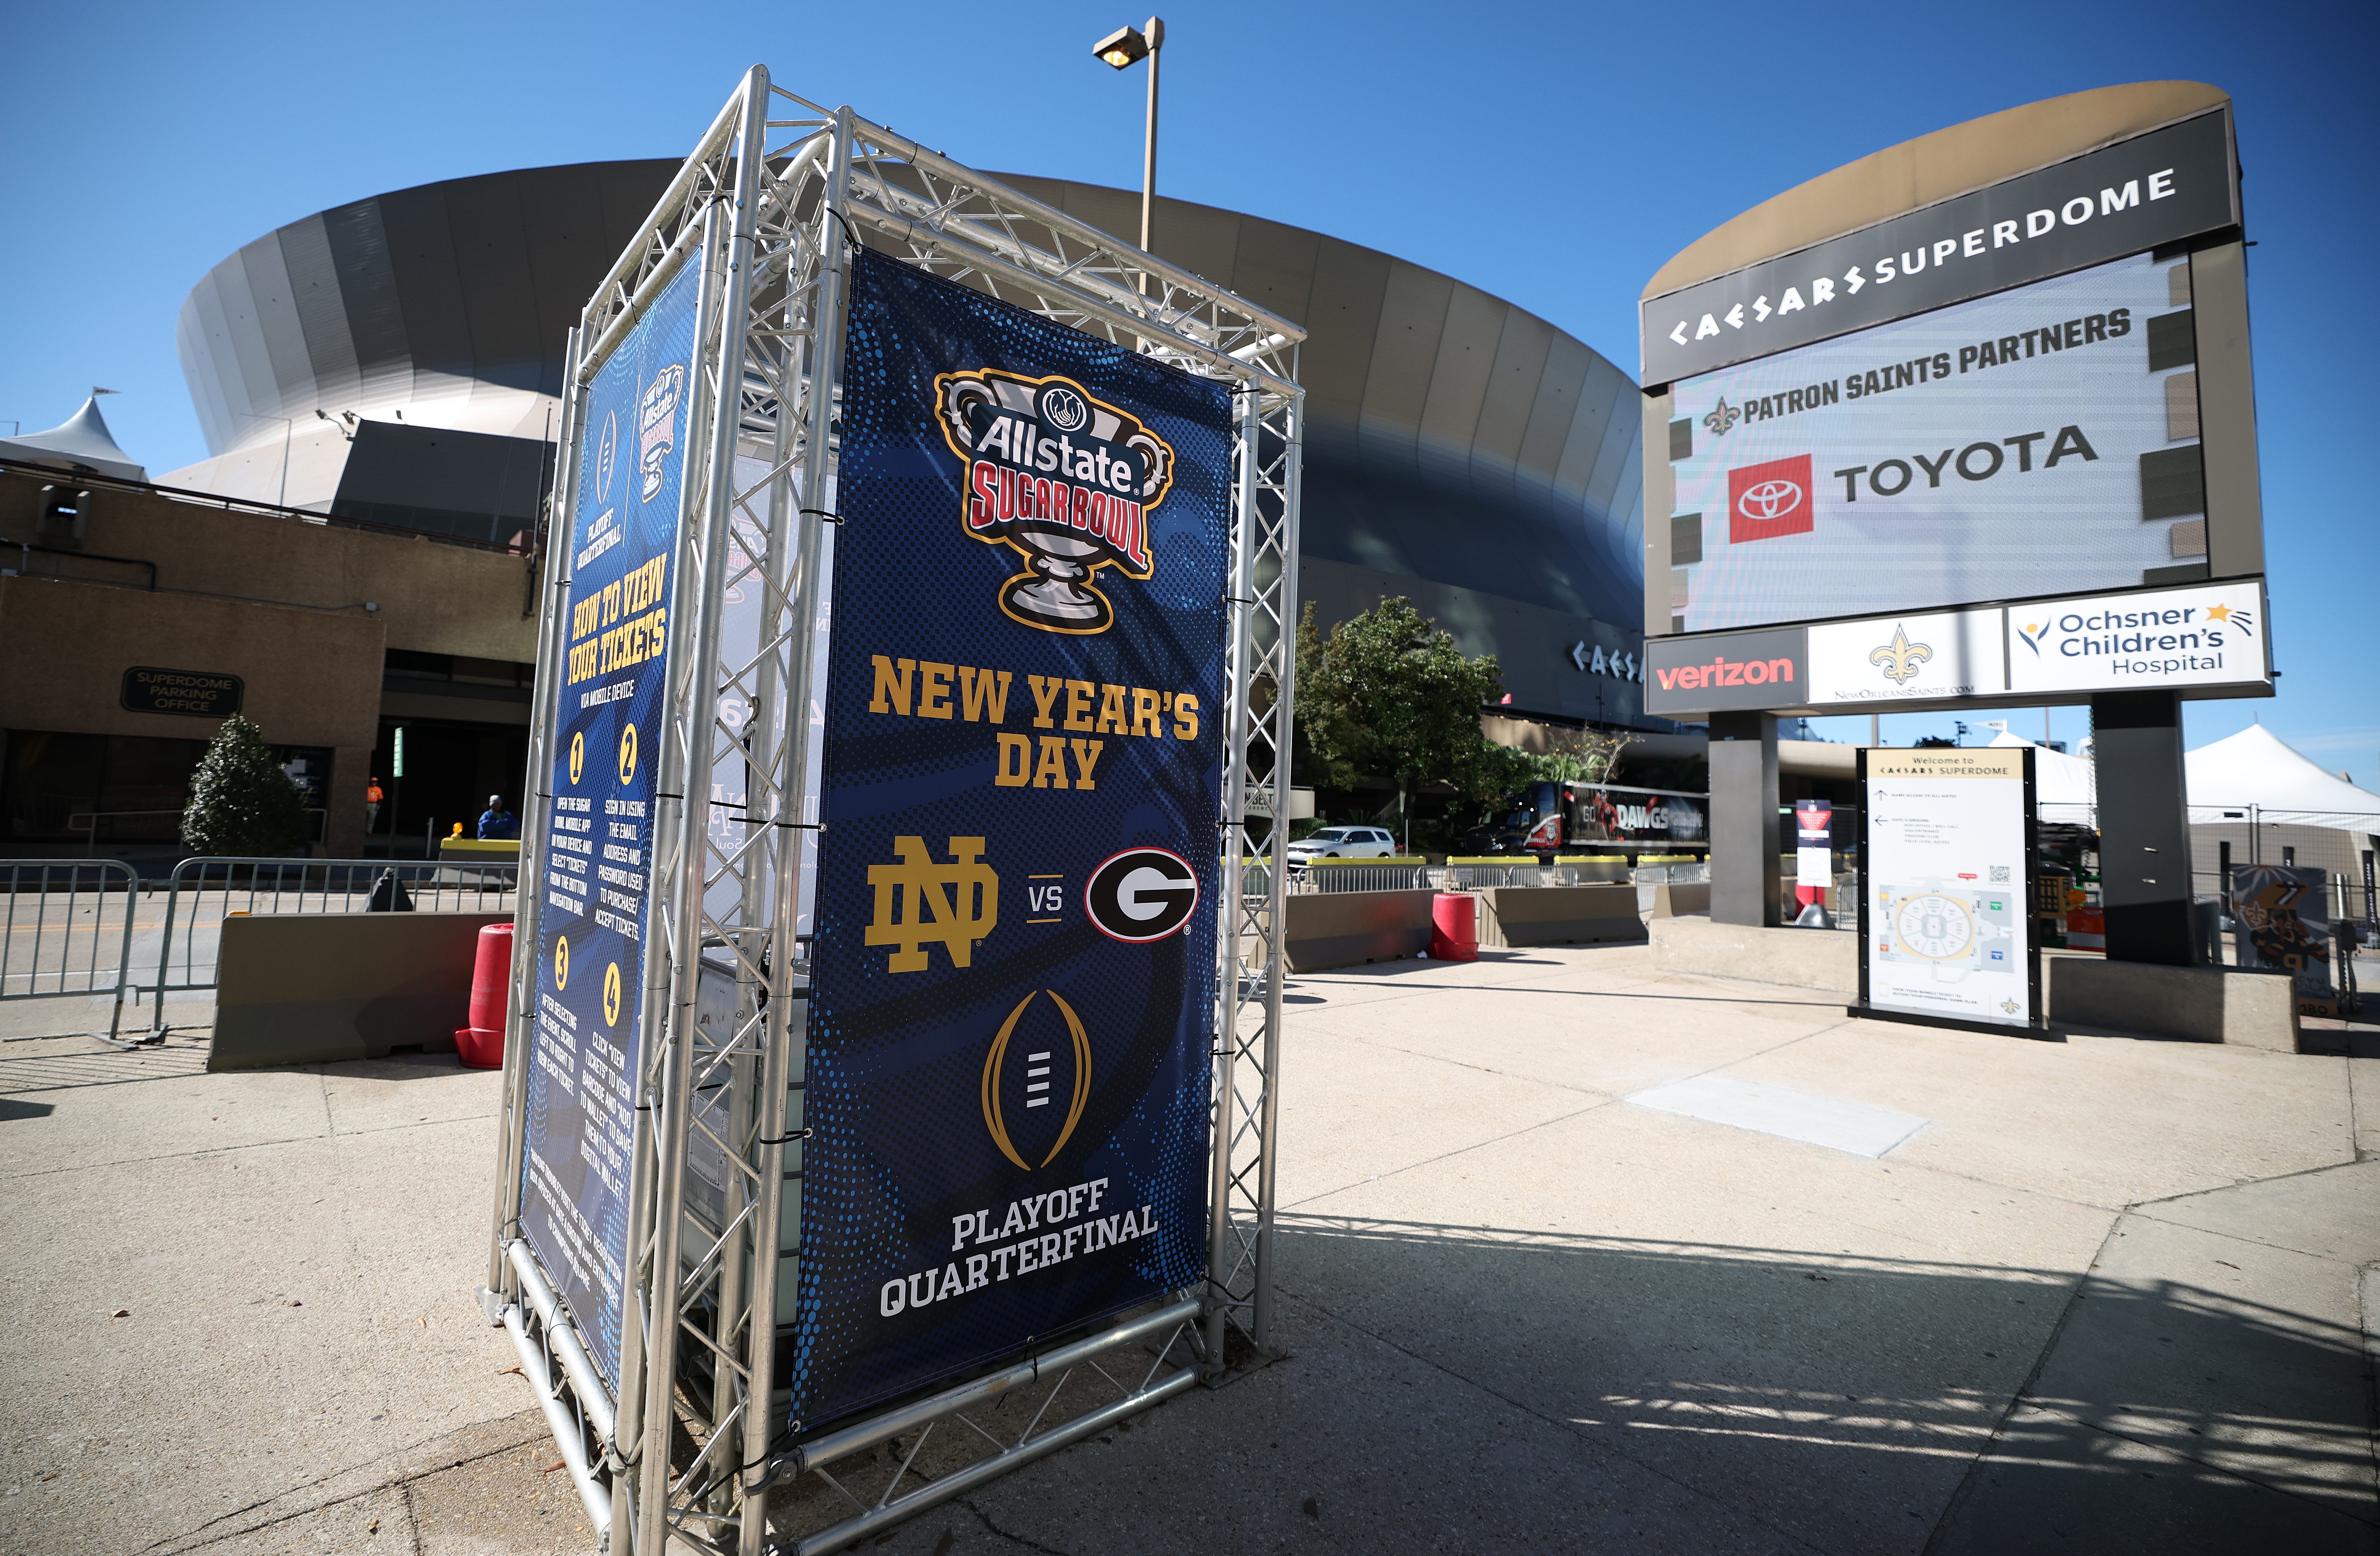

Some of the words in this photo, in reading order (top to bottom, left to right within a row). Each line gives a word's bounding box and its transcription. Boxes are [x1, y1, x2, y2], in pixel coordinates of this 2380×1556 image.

[1669, 265, 1866, 345] CAESARS
[1874, 168, 2176, 285] SUPERDOME
[1744, 377, 1839, 424] PATRON
[1846, 352, 1951, 401] SAINTS
[1960, 308, 2130, 375] PARTNERS
[1834, 425, 2098, 502] TOYOTA
[588, 508, 614, 543] PLAYOFF
[970, 460, 1070, 529] SUGAR
[1071, 485, 1148, 570] BOWL
[577, 524, 621, 570] QUARTERFINAL
[572, 591, 600, 642] HOW
[602, 580, 620, 627] TO
[623, 552, 667, 617] VIEW
[2060, 605, 2195, 634] Ochsner
[568, 638, 598, 686] YOUR
[600, 608, 666, 674] TICKETS
[2113, 652, 2222, 676] Hospital
[137, 673, 232, 689] SUPERDOME
[150, 686, 217, 700] PARKING
[1656, 658, 1793, 692] verizon
[155, 698, 210, 711] OFFICE
[581, 690, 590, 708] VIA
[590, 686, 611, 705] MOBILE
[612, 679, 635, 701] DEVICE
[869, 655, 1012, 724] NEW
[1028, 675, 1199, 740] YEAR'S
[573, 739, 580, 778] 1
[623, 732, 632, 777] 2
[995, 732, 1104, 790] DAY
[557, 797, 567, 810] OPEN
[576, 798, 590, 812] SUGAR
[605, 800, 618, 815] SIGN
[619, 801, 625, 815] IN
[627, 801, 645, 817] USING
[1616, 804, 1669, 829] DAWGS
[555, 815, 565, 829] BOWL
[566, 817, 581, 832] MOBILE
[581, 819, 590, 833] APP
[609, 822, 619, 837] THE
[620, 824, 637, 840] EMAIL
[552, 853, 567, 868] SELECT
[556, 835, 567, 849] YOUR
[567, 836, 582, 853] DEVICE
[582, 839, 592, 855] AND
[603, 843, 628, 862] ADDRESS
[628, 848, 640, 865] AND
[550, 871, 560, 887] FROM
[569, 877, 587, 896] BOTTOM
[598, 865, 627, 887] PASSWORD
[628, 872, 643, 891] USED
[550, 890, 573, 912] NAVIGATION
[574, 900, 583, 916] BAR.
[600, 887, 607, 902] TO
[607, 890, 638, 915] PURCHASE/
[1029, 886, 1062, 912] VS
[595, 908, 615, 928] ACCEPT
[615, 916, 639, 941] TICKETS.
[558, 943, 566, 983] 3
[542, 993, 554, 1013] AFTER
[554, 1002, 577, 1030] SELECTING
[607, 971, 616, 1020] 4
[540, 1031, 549, 1049] LEFT
[549, 1038, 555, 1055] TO
[555, 1044, 568, 1067] RIGHT
[568, 1055, 574, 1073] TO
[548, 1017, 560, 1041] EVENT,
[561, 1028, 576, 1053] SCROLL
[593, 1032, 608, 1057] CLICK
[537, 1048, 548, 1069] VIEW
[547, 1058, 558, 1080] EACH
[559, 1068, 574, 1097] TICKET.
[609, 1068, 615, 1088] TO
[616, 1075, 631, 1102] VIEW
[582, 1069, 605, 1104] BARCODE
[605, 1091, 616, 1115] AND
[581, 1090, 586, 1109] TO
[609, 1119, 616, 1140] TO
[616, 1128, 631, 1157] SAVE
[585, 1119, 599, 1147] THEM
[599, 1134, 606, 1155] TO
[607, 1143, 622, 1173] YOUR
[581, 1139, 601, 1175] DIGITAL
[602, 1162, 623, 1202] WALLET.
[545, 1163, 561, 1196] TROUBLE?
[561, 1188, 570, 1212] VISIT
[579, 1213, 593, 1244] TICKET
[593, 1234, 622, 1286] RESOLUTION
[952, 1177, 1108, 1252] PLAYOFF
[530, 1168, 538, 1186] BOX
[538, 1176, 552, 1205] OFFICES
[551, 1198, 556, 1214] AT
[555, 1204, 564, 1227] GATE
[564, 1218, 567, 1230] A
[567, 1223, 581, 1255] GROUND
[581, 1247, 593, 1268] AND
[593, 1258, 618, 1309] ENTRANCES
[548, 1214, 552, 1231] TO
[552, 1221, 573, 1265] CHAMPIONS
[573, 1258, 590, 1292] SQUARE.
[880, 1204, 1158, 1318] QUARTERFINAL
